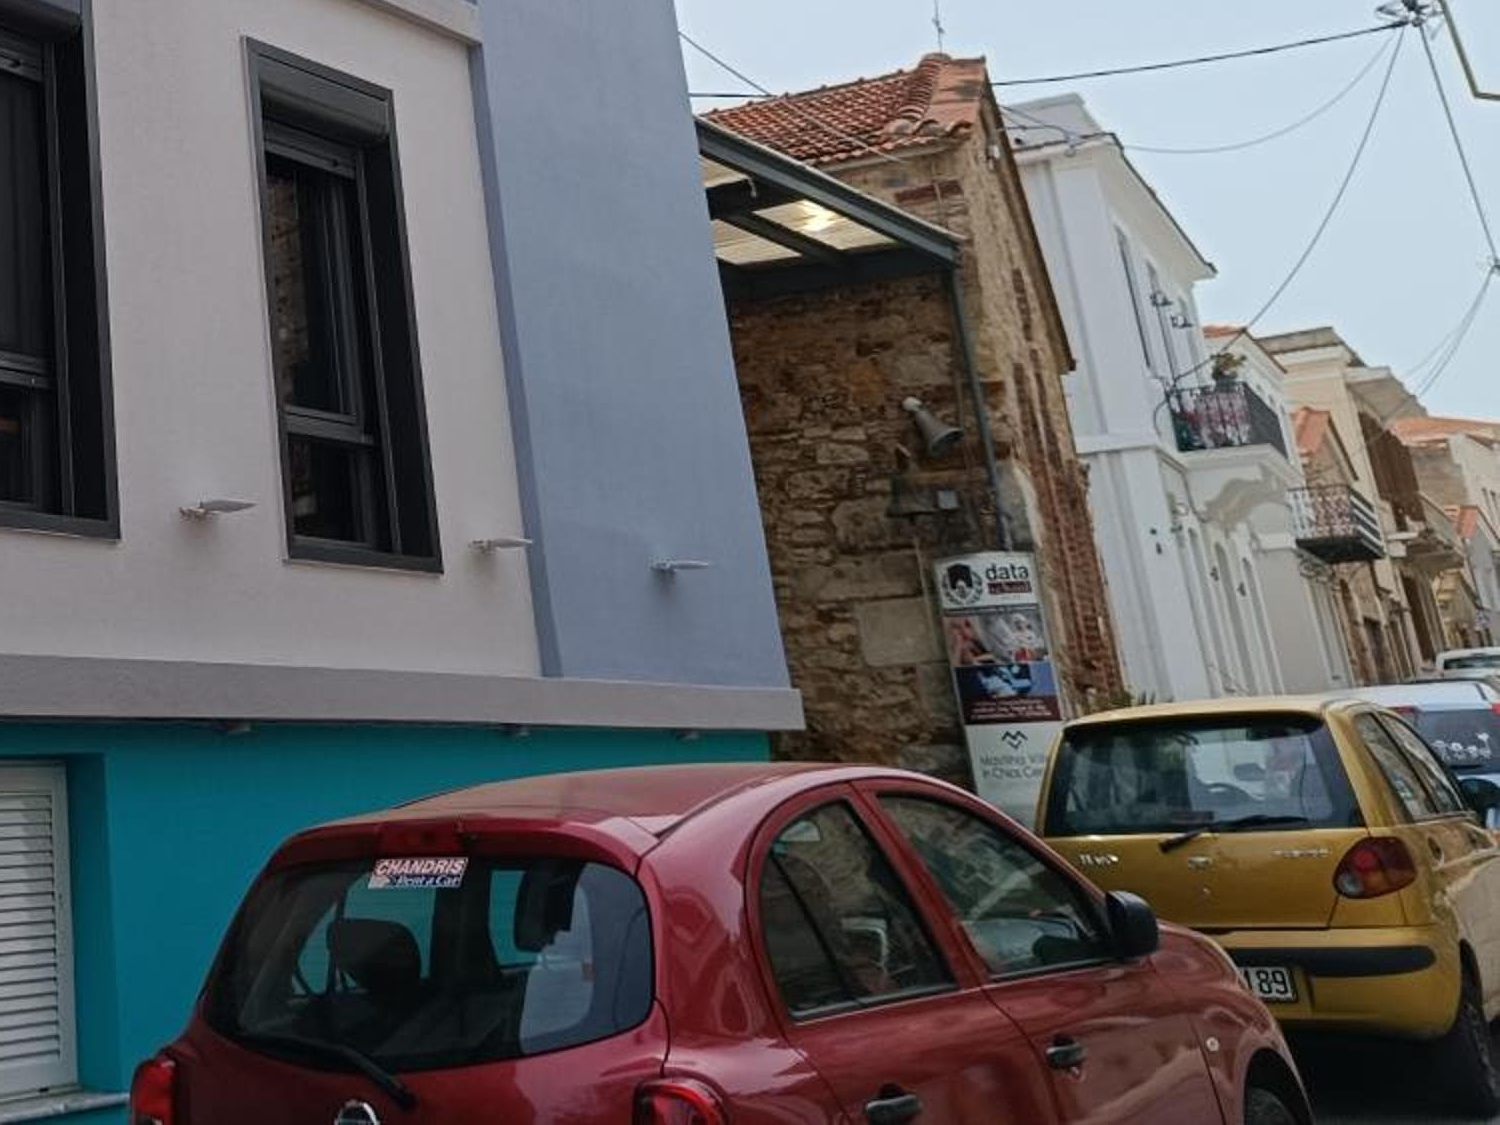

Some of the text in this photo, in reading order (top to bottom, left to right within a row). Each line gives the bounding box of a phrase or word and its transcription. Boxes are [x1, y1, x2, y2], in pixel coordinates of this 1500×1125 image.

[985, 562, 1029, 580] data
[375, 858, 465, 875] CHANDRIS
[435, 875, 461, 886] Car
